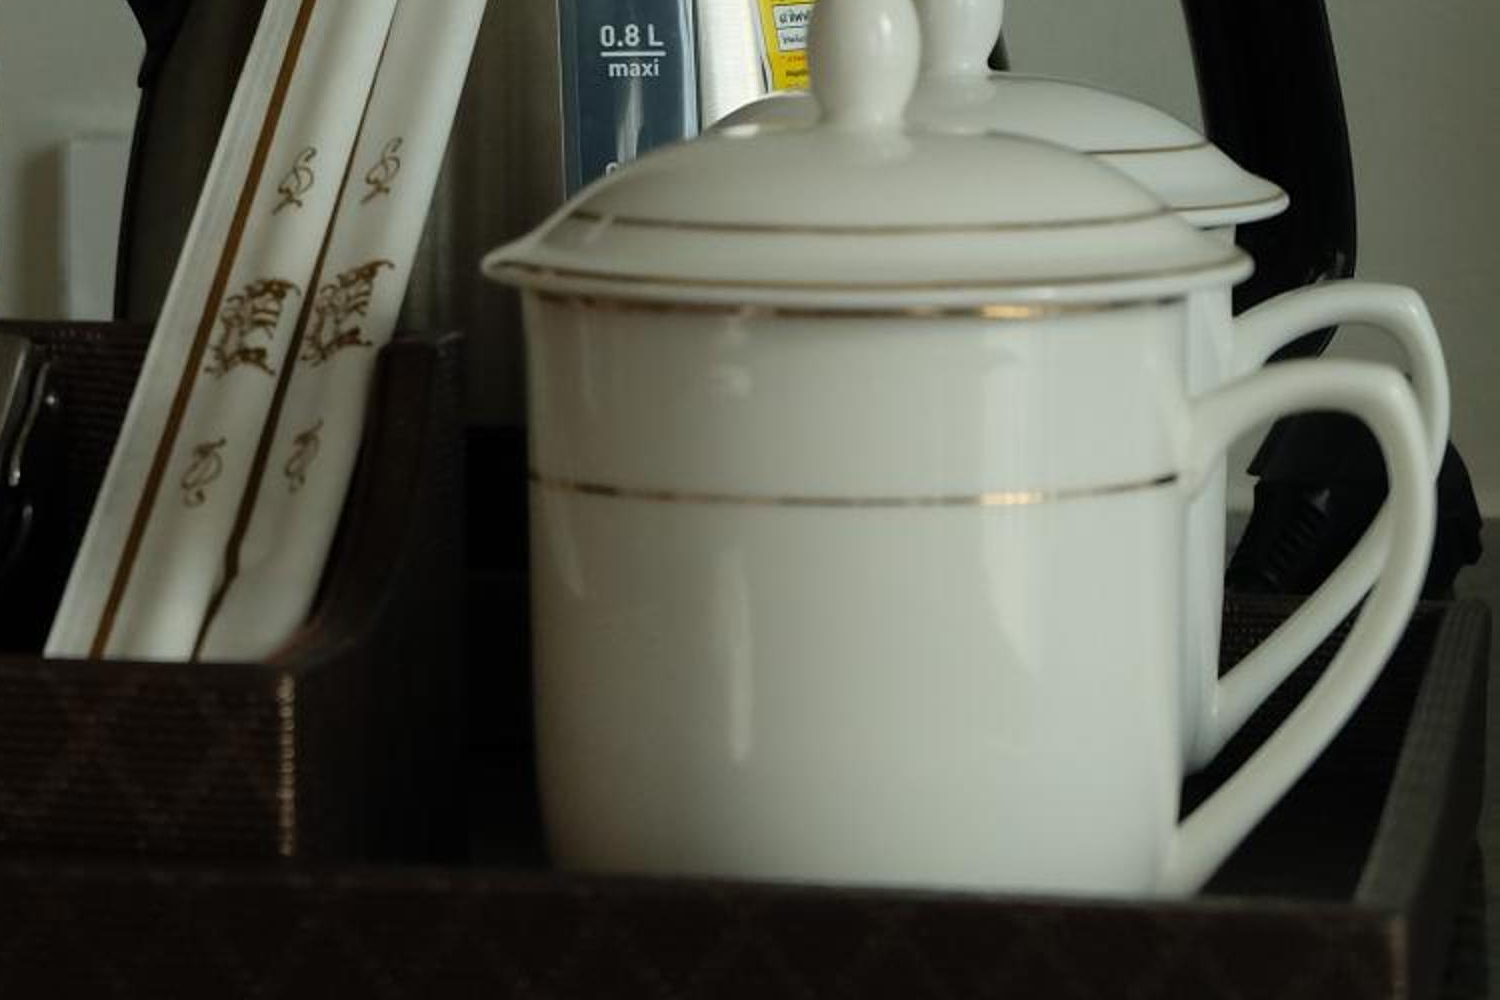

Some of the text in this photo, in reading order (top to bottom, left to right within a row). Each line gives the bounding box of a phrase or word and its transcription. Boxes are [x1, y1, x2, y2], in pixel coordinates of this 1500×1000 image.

[600, 23, 665, 48] 0.8 L
[609, 57, 660, 78] maxi
